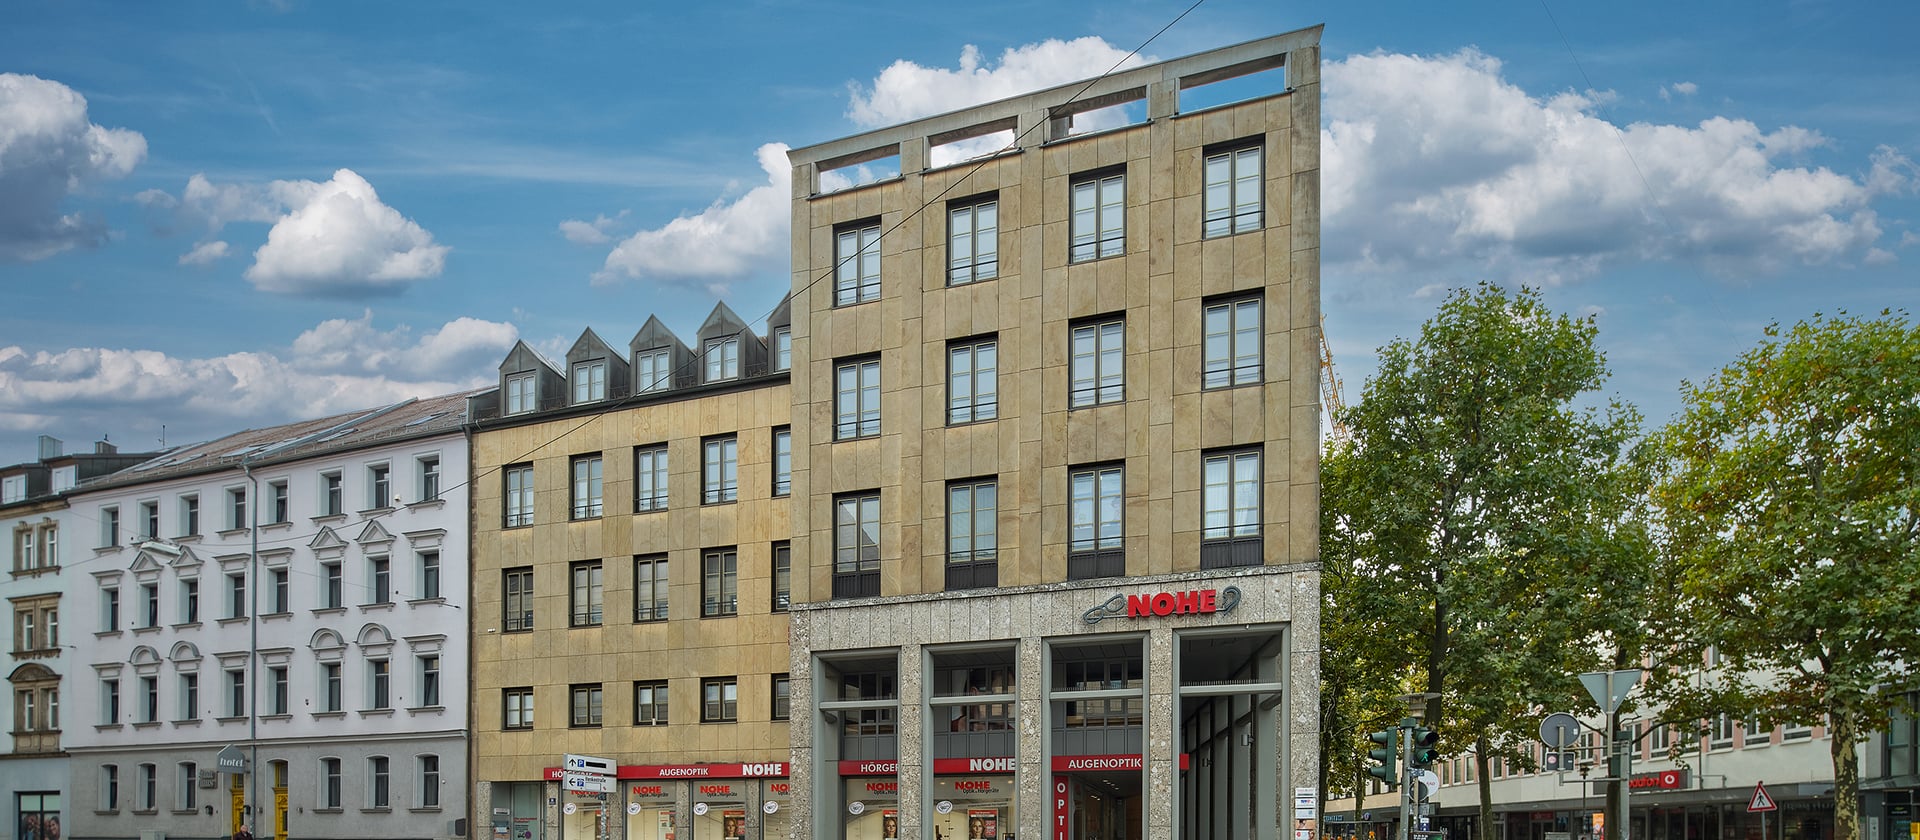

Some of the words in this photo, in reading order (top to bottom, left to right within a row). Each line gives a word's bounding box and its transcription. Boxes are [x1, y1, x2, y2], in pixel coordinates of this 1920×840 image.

[1128, 589, 1216, 618] NOHE
[220, 757, 244, 767] hotel
[860, 762, 898, 772] HÖRGE
[969, 758, 1016, 771] NOHE
[1068, 758, 1141, 769] AUGENOPTIK
[659, 767, 709, 776] AUGENOPTIK
[742, 763, 782, 776] NOHE
[633, 786, 662, 794] NOHE
[700, 785, 730, 793] NOHE
[954, 781, 990, 790] NOHE
[1057, 782, 1066, 840] OPTI
